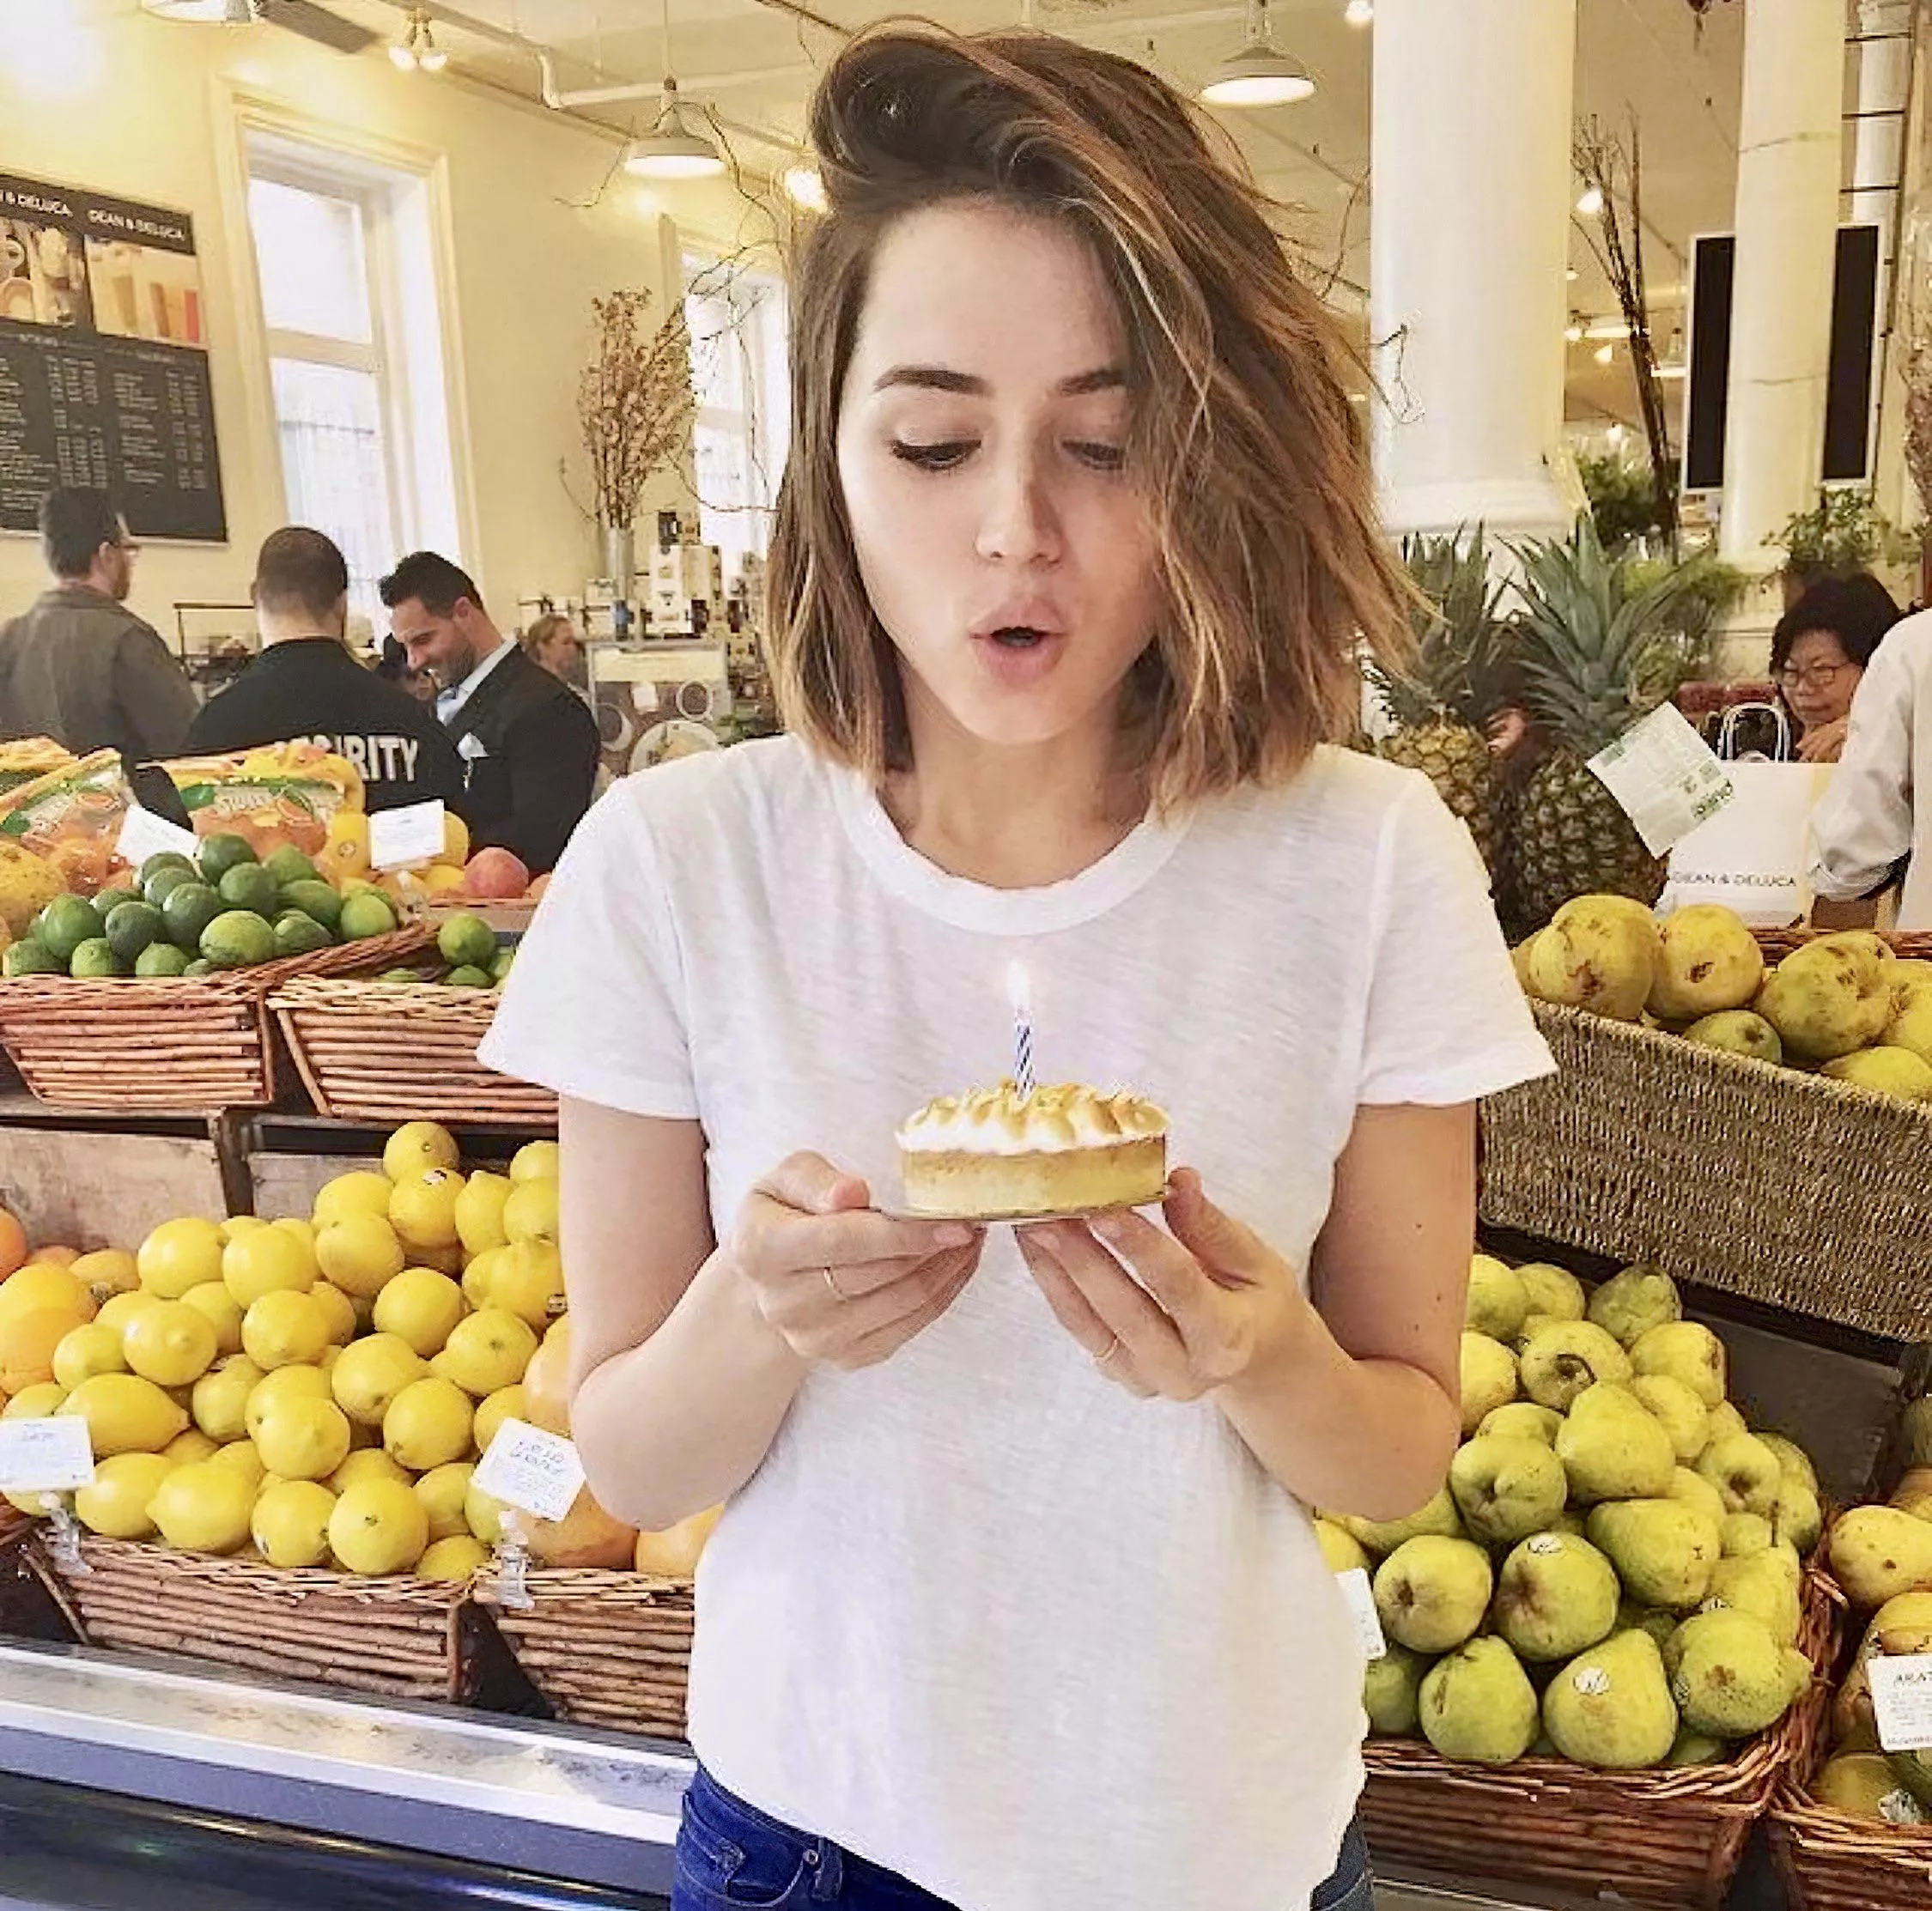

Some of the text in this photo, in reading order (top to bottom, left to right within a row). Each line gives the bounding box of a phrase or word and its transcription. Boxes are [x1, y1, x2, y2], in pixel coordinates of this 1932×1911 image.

[17, 193, 73, 217] DELUCA
[88, 209, 125, 228] DEAN
[135, 220, 185, 241] DELUCA
[1674, 871, 1716, 884] DEAN
[1733, 874, 1797, 888] DELUCA
